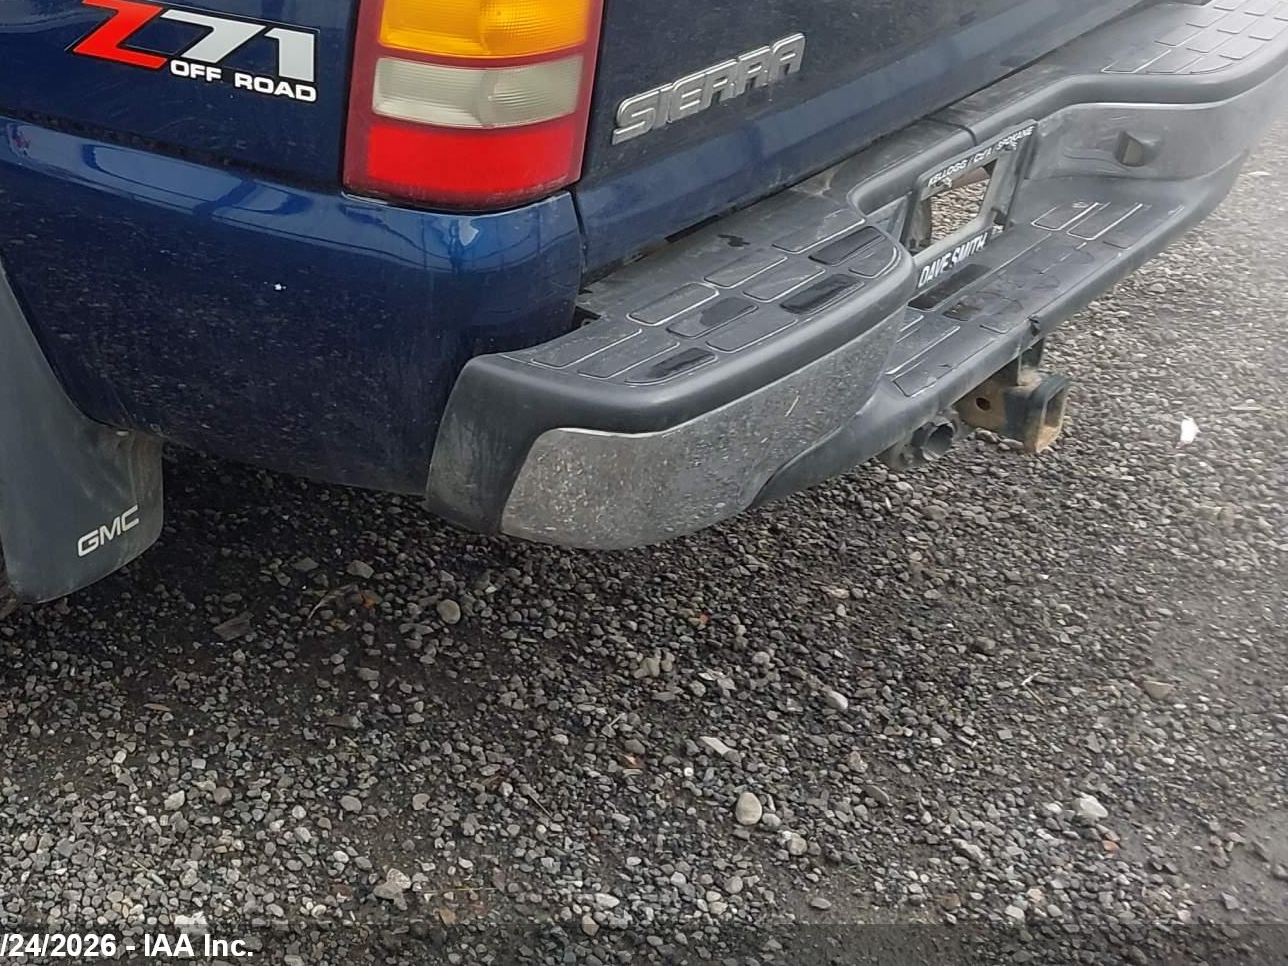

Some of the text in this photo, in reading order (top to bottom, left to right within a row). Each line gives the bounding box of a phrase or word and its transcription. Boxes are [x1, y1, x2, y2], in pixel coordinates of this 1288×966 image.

[169, 59, 317, 103] OFF ROAD
[612, 33, 806, 145] SIERRA
[918, 231, 989, 289] DAVE SMITH
[77, 504, 140, 557] GMC
